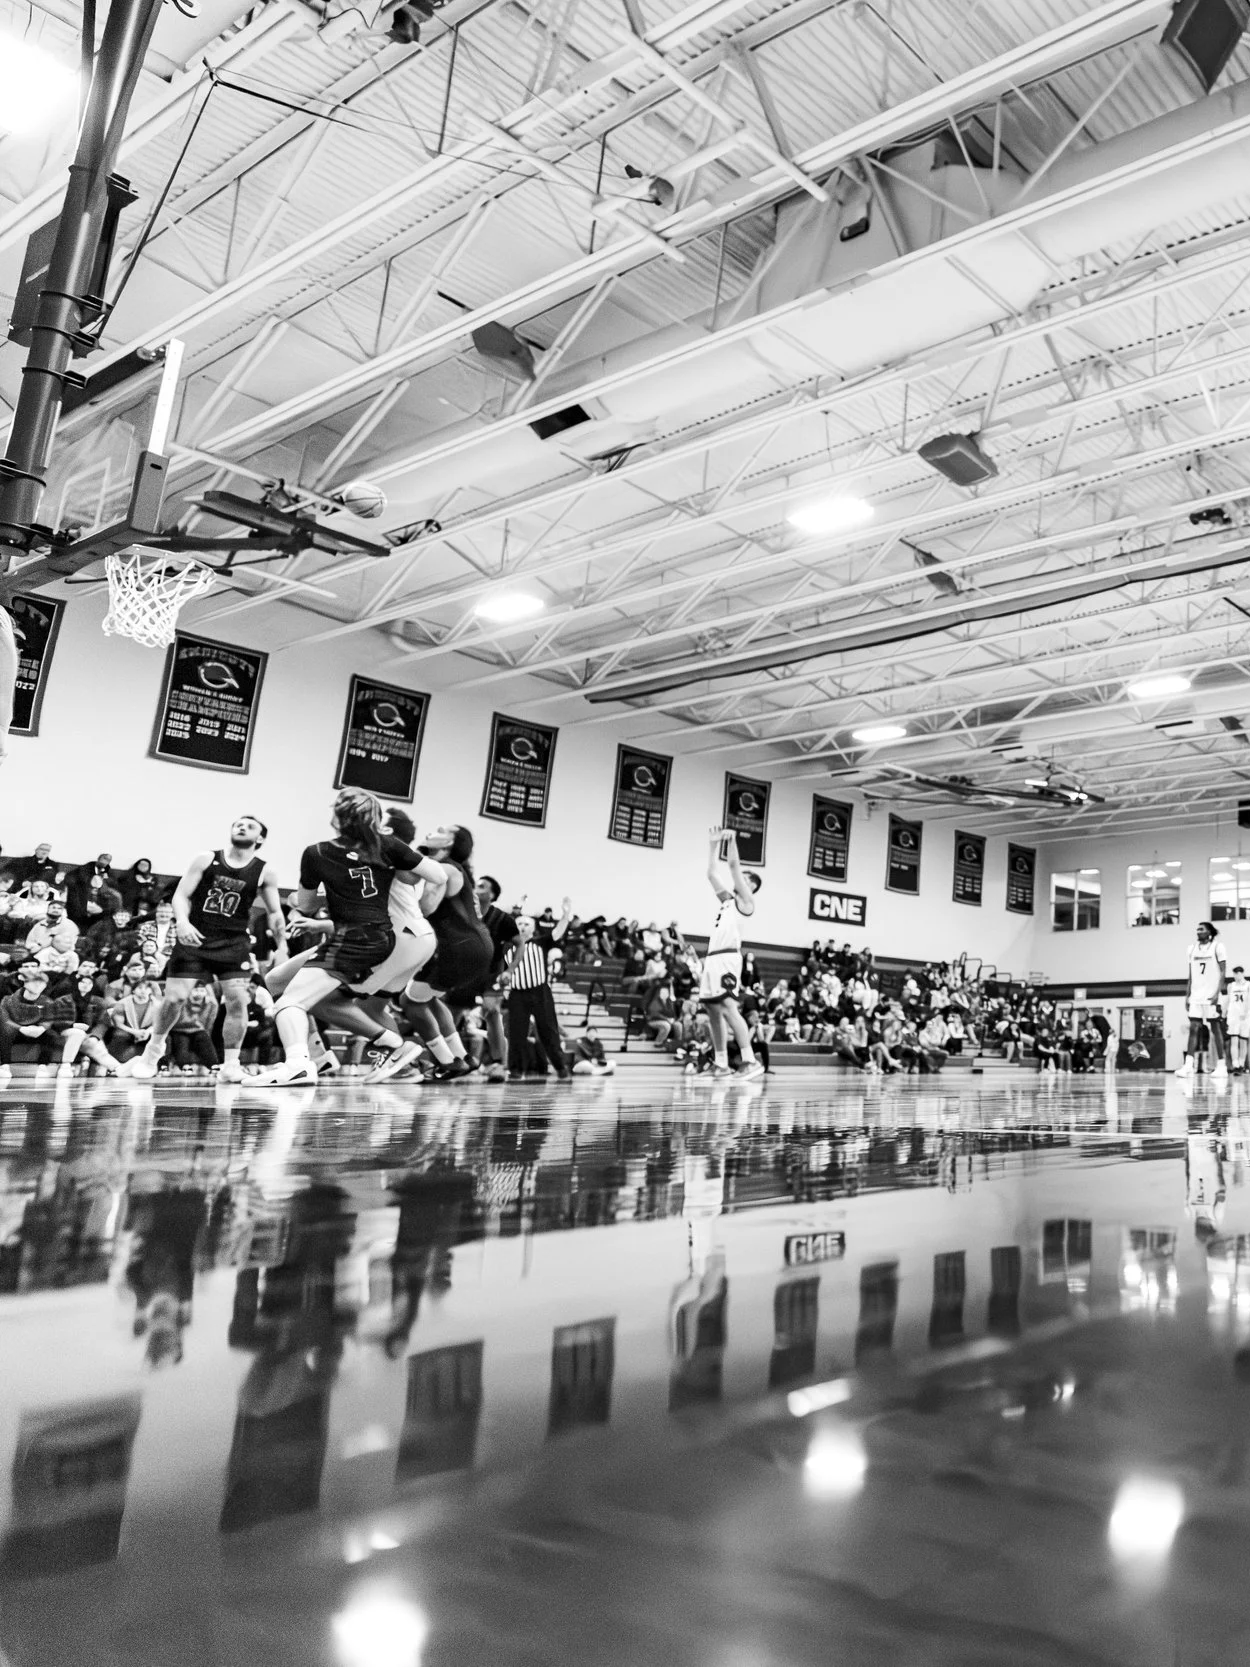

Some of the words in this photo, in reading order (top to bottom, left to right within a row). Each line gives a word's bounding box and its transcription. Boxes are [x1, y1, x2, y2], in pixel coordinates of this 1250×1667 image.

[348, 866, 378, 898] 7
[203, 888, 241, 917] 20
[813, 893, 863, 922] CNE
[1199, 962, 1206, 975] 7
